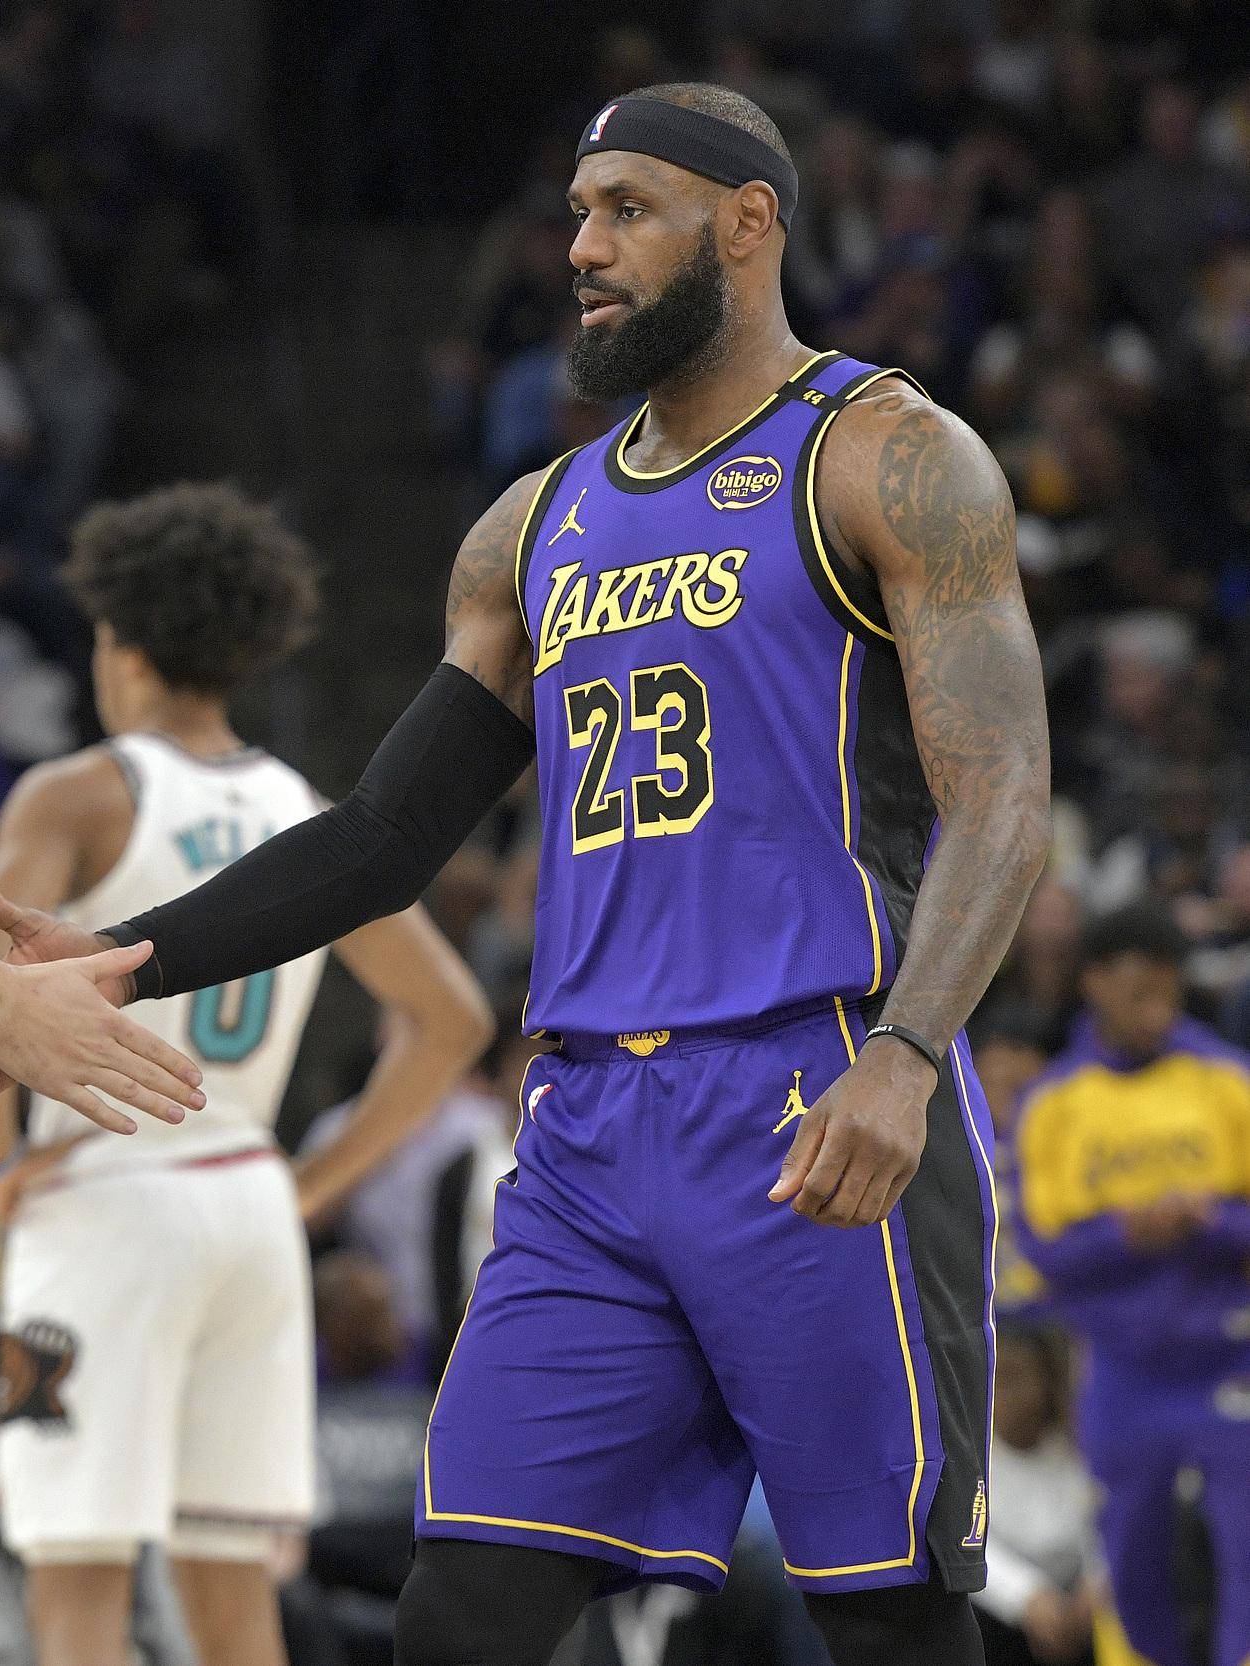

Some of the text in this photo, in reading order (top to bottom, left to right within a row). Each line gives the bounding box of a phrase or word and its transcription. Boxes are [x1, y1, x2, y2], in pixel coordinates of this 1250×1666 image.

[803, 390, 825, 405] 44
[714, 470, 777, 492] bibigo
[722, 487, 749, 498] 비비고
[533, 548, 749, 677] LAKERS
[563, 662, 713, 856] 23
